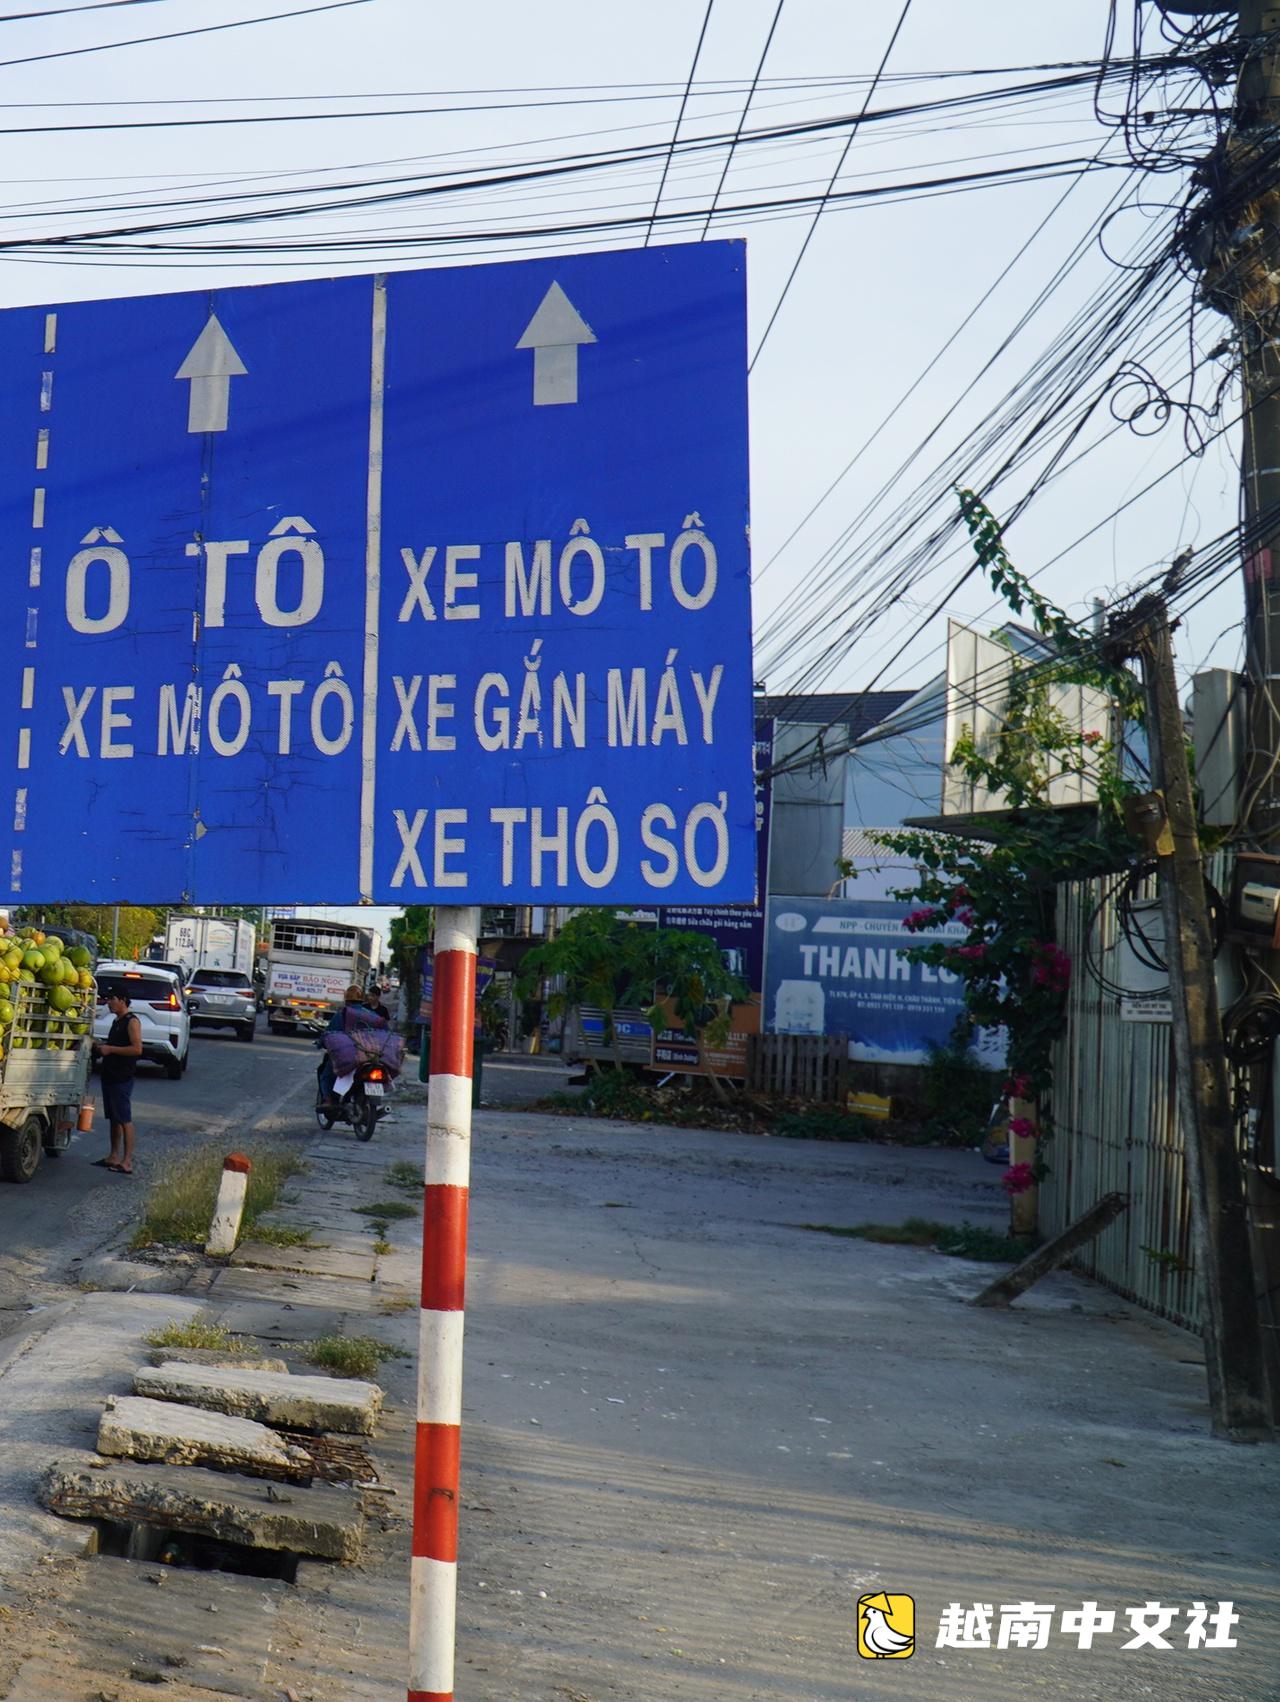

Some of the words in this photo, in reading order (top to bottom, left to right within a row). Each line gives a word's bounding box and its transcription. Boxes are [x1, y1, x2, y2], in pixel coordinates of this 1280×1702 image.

[65, 526, 131, 634] Ô
[185, 516, 325, 628] TÔ
[398, 545, 481, 623] XE
[504, 518, 606, 617] MÔ
[625, 511, 718, 611] TÔ
[59, 685, 135, 760] XE
[157, 663, 252, 757] MÔ
[267, 661, 355, 756] TÔ
[390, 674, 457, 752] XE
[474, 638, 586, 752] GẮN
[607, 648, 724, 747] MÁY
[390, 808, 468, 888] XE
[490, 786, 619, 888] THÔ
[641, 791, 730, 888] SƠ
[799, 945, 912, 982] THANH
